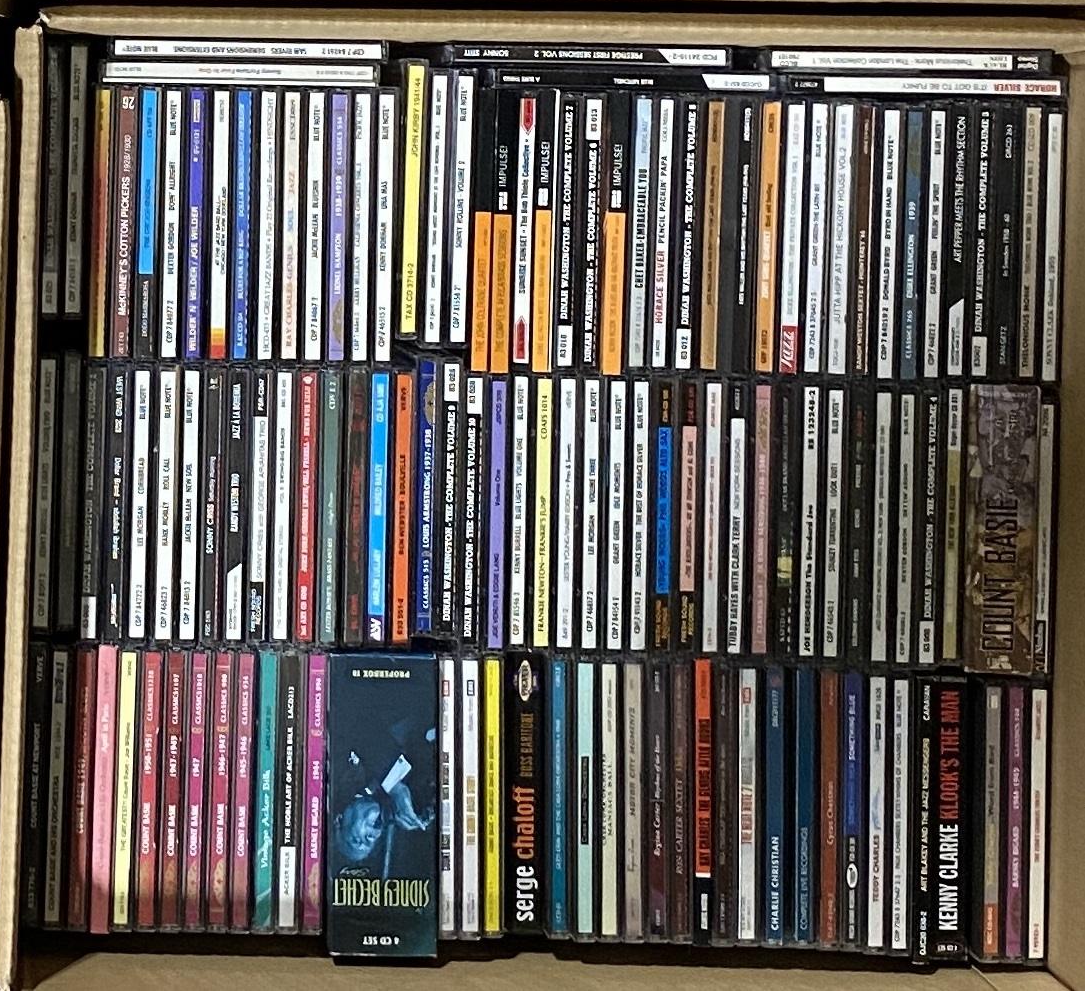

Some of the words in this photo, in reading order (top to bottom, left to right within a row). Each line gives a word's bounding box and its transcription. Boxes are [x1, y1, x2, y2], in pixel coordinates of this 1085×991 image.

[499, 145, 507, 186] IMPULSE!
[614, 144, 622, 186] IMPULSE!
[120, 177, 130, 216] PICKERS
[655, 280, 663, 324] HORACE
[985, 500, 1018, 565] BASIE
[942, 690, 959, 723] MAN
[941, 727, 958, 749] THE
[521, 756, 532, 777] BOSS
[939, 753, 958, 819] KLOOK'S
[513, 786, 535, 859] chaloff
[772, 837, 780, 889] CHRISTIAN
[939, 824, 958, 881] CLARKE
[333, 879, 381, 906] BECHET
[384, 880, 429, 907] SIDNEY
[517, 866, 538, 922] serge
[771, 891, 780, 931] CHARLIE
[939, 885, 958, 931] KENNY
[363, 936, 377, 944] SET
